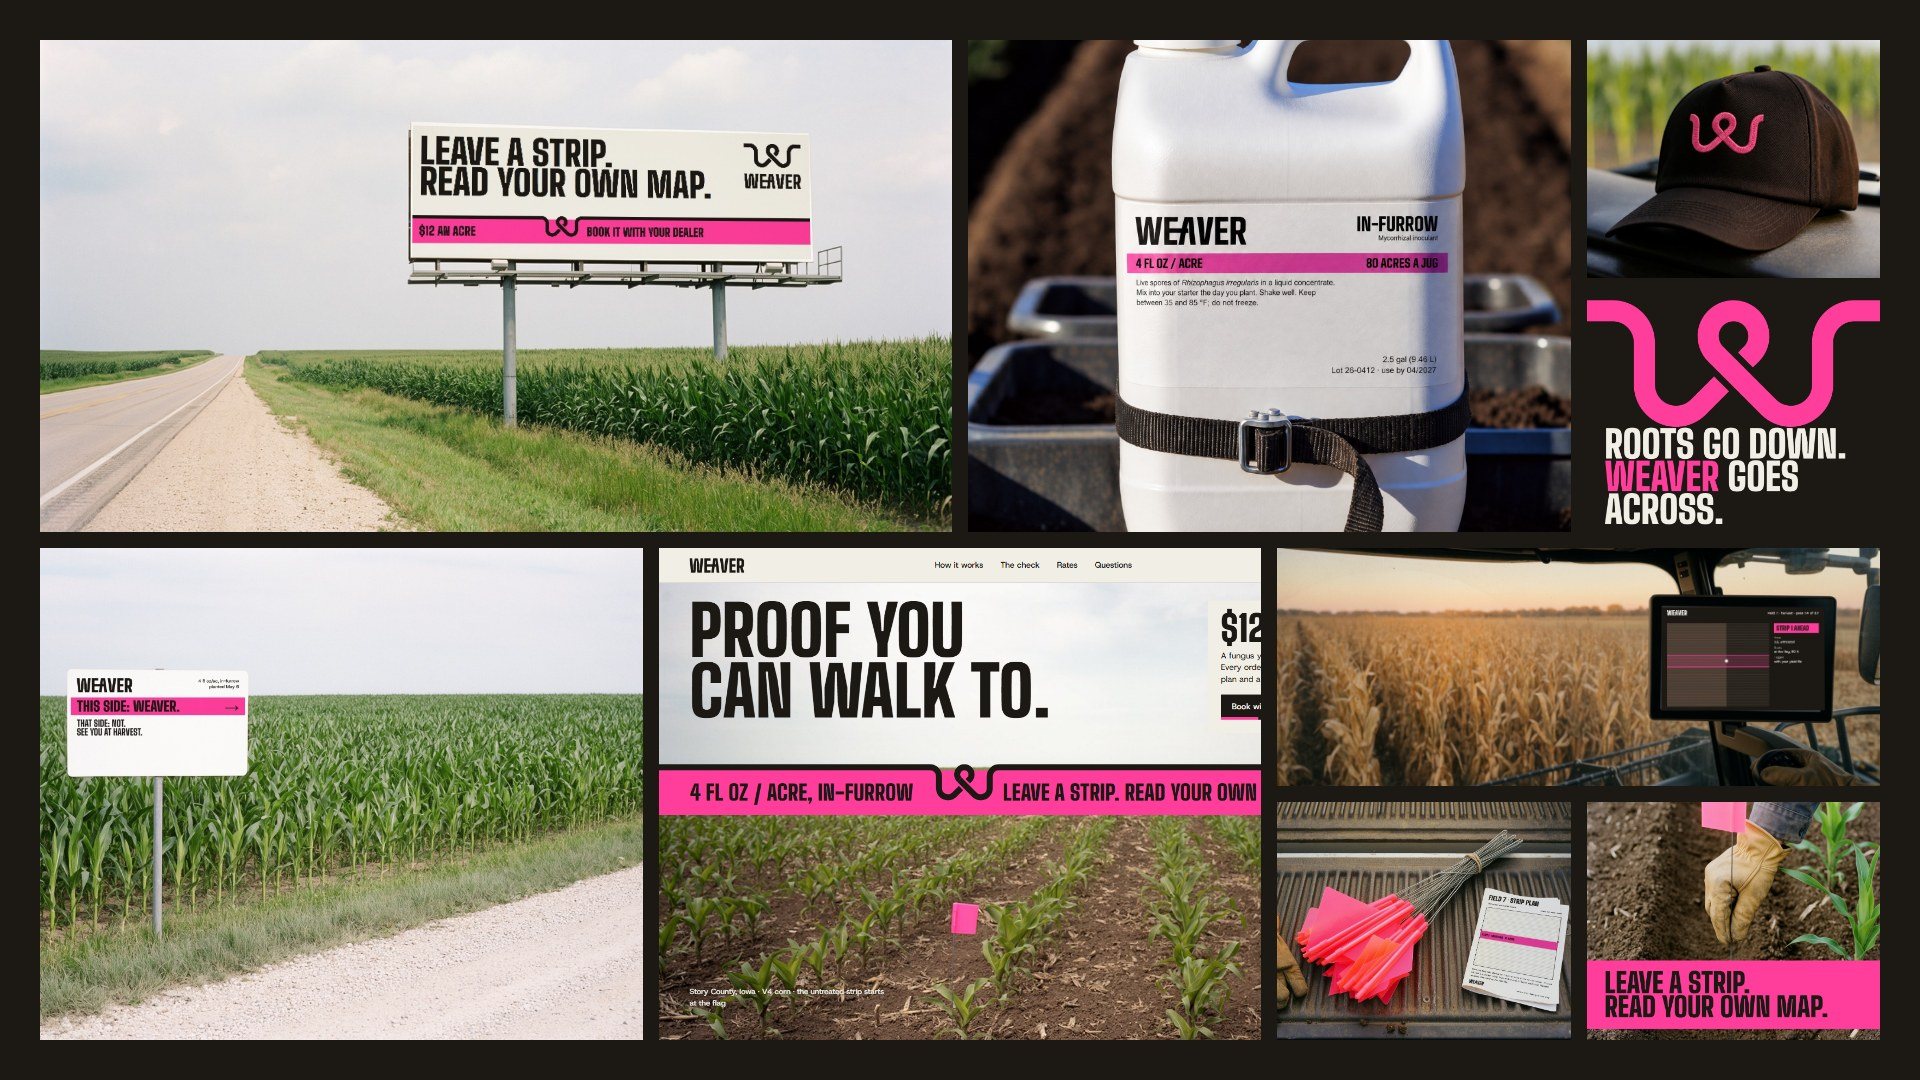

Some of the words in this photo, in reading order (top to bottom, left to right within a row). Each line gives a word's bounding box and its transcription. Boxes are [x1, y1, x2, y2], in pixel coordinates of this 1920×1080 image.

[421, 136, 499, 167] LEAVE
[507, 138, 524, 167] A
[533, 139, 612, 167] STRIP.
[421, 166, 488, 196] READ
[498, 169, 566, 197] YOUR
[575, 169, 637, 198] OWN
[648, 170, 711, 199] MAP.
[744, 173, 801, 189] WEAVER
[419, 224, 434, 237] $12
[438, 226, 450, 236] AN
[453, 226, 476, 236] ACRE
[587, 226, 610, 237] BOOK
[613, 227, 620, 237] IT
[623, 227, 645, 237] WITH
[649, 227, 670, 237] YOUR
[673, 227, 703, 237] DEALER
[1136, 217, 1246, 245] WEAVER
[1357, 216, 1438, 232] IN-FURROW
[1136, 258, 1141, 268] 4
[1144, 258, 1155, 268] FL
[1157, 258, 1168, 268] OZ
[1178, 258, 1203, 268] ACRE
[1366, 258, 1378, 268] 80
[1380, 258, 1411, 268] ACRES
[1413, 258, 1419, 268] A
[1421, 258, 1438, 268] JUG
[1240, 289, 1257, 297] plant.
[1396, 356, 1407, 364] gal
[1409, 356, 1428, 364] (9.46
[1430, 356, 1437, 364] L)
[1397, 367, 1404, 375] by
[1606, 428, 1694, 459] ROOTS
[1704, 428, 1740, 459] GO
[1750, 428, 1846, 459] DOWN.
[1605, 460, 1719, 491] WEAVER
[1729, 460, 1798, 492] GOES
[1605, 493, 1723, 524] ACROSS.
[690, 558, 744, 573] WEAVER
[934, 561, 952, 569] How
[953, 561, 959, 569] it
[961, 561, 984, 569] works
[692, 601, 850, 657] PROOF
[867, 601, 962, 657] YOU
[1222, 609, 1261, 646] $12
[1229, 652, 1254, 660] fungus
[1221, 664, 1241, 672] Every
[77, 678, 132, 692] WEAVER
[1221, 676, 1236, 684] plan
[692, 662, 790, 718] CAN
[810, 662, 955, 718] WALK
[971, 662, 1048, 718] TO.
[77, 700, 100, 712] THIS
[103, 700, 129, 712] SIDE:
[133, 700, 179, 712] WEAVER.
[77, 719, 92, 727] THAT
[94, 719, 110, 727] SIDE:
[112, 719, 125, 727] NOT.
[77, 728, 88, 736] SEE
[90, 728, 102, 736] YOU
[104, 728, 111, 736] AT
[113, 728, 142, 736] HARVEST.
[690, 785, 701, 802] 4
[706, 785, 724, 802] FL
[729, 785, 748, 802] OZ
[767, 785, 812, 805] ACRE,
[818, 783, 913, 803] IN-FURROW
[1003, 783, 1050, 802] LEAVE
[1054, 783, 1065, 802] A
[1071, 783, 1119, 802] STRIP.
[1126, 783, 1165, 802] READ
[1171, 783, 1213, 802] YOUR
[1218, 783, 1257, 802] OWN
[1605, 971, 1663, 993] LEAVE
[1669, 971, 1682, 993] A
[1688, 971, 1750, 993] STRIP.
[1605, 995, 1655, 1017] READ
[1662, 995, 1713, 1017] YOUR
[1720, 995, 1770, 1017] OWN
[1777, 995, 1827, 1017] MAP.
